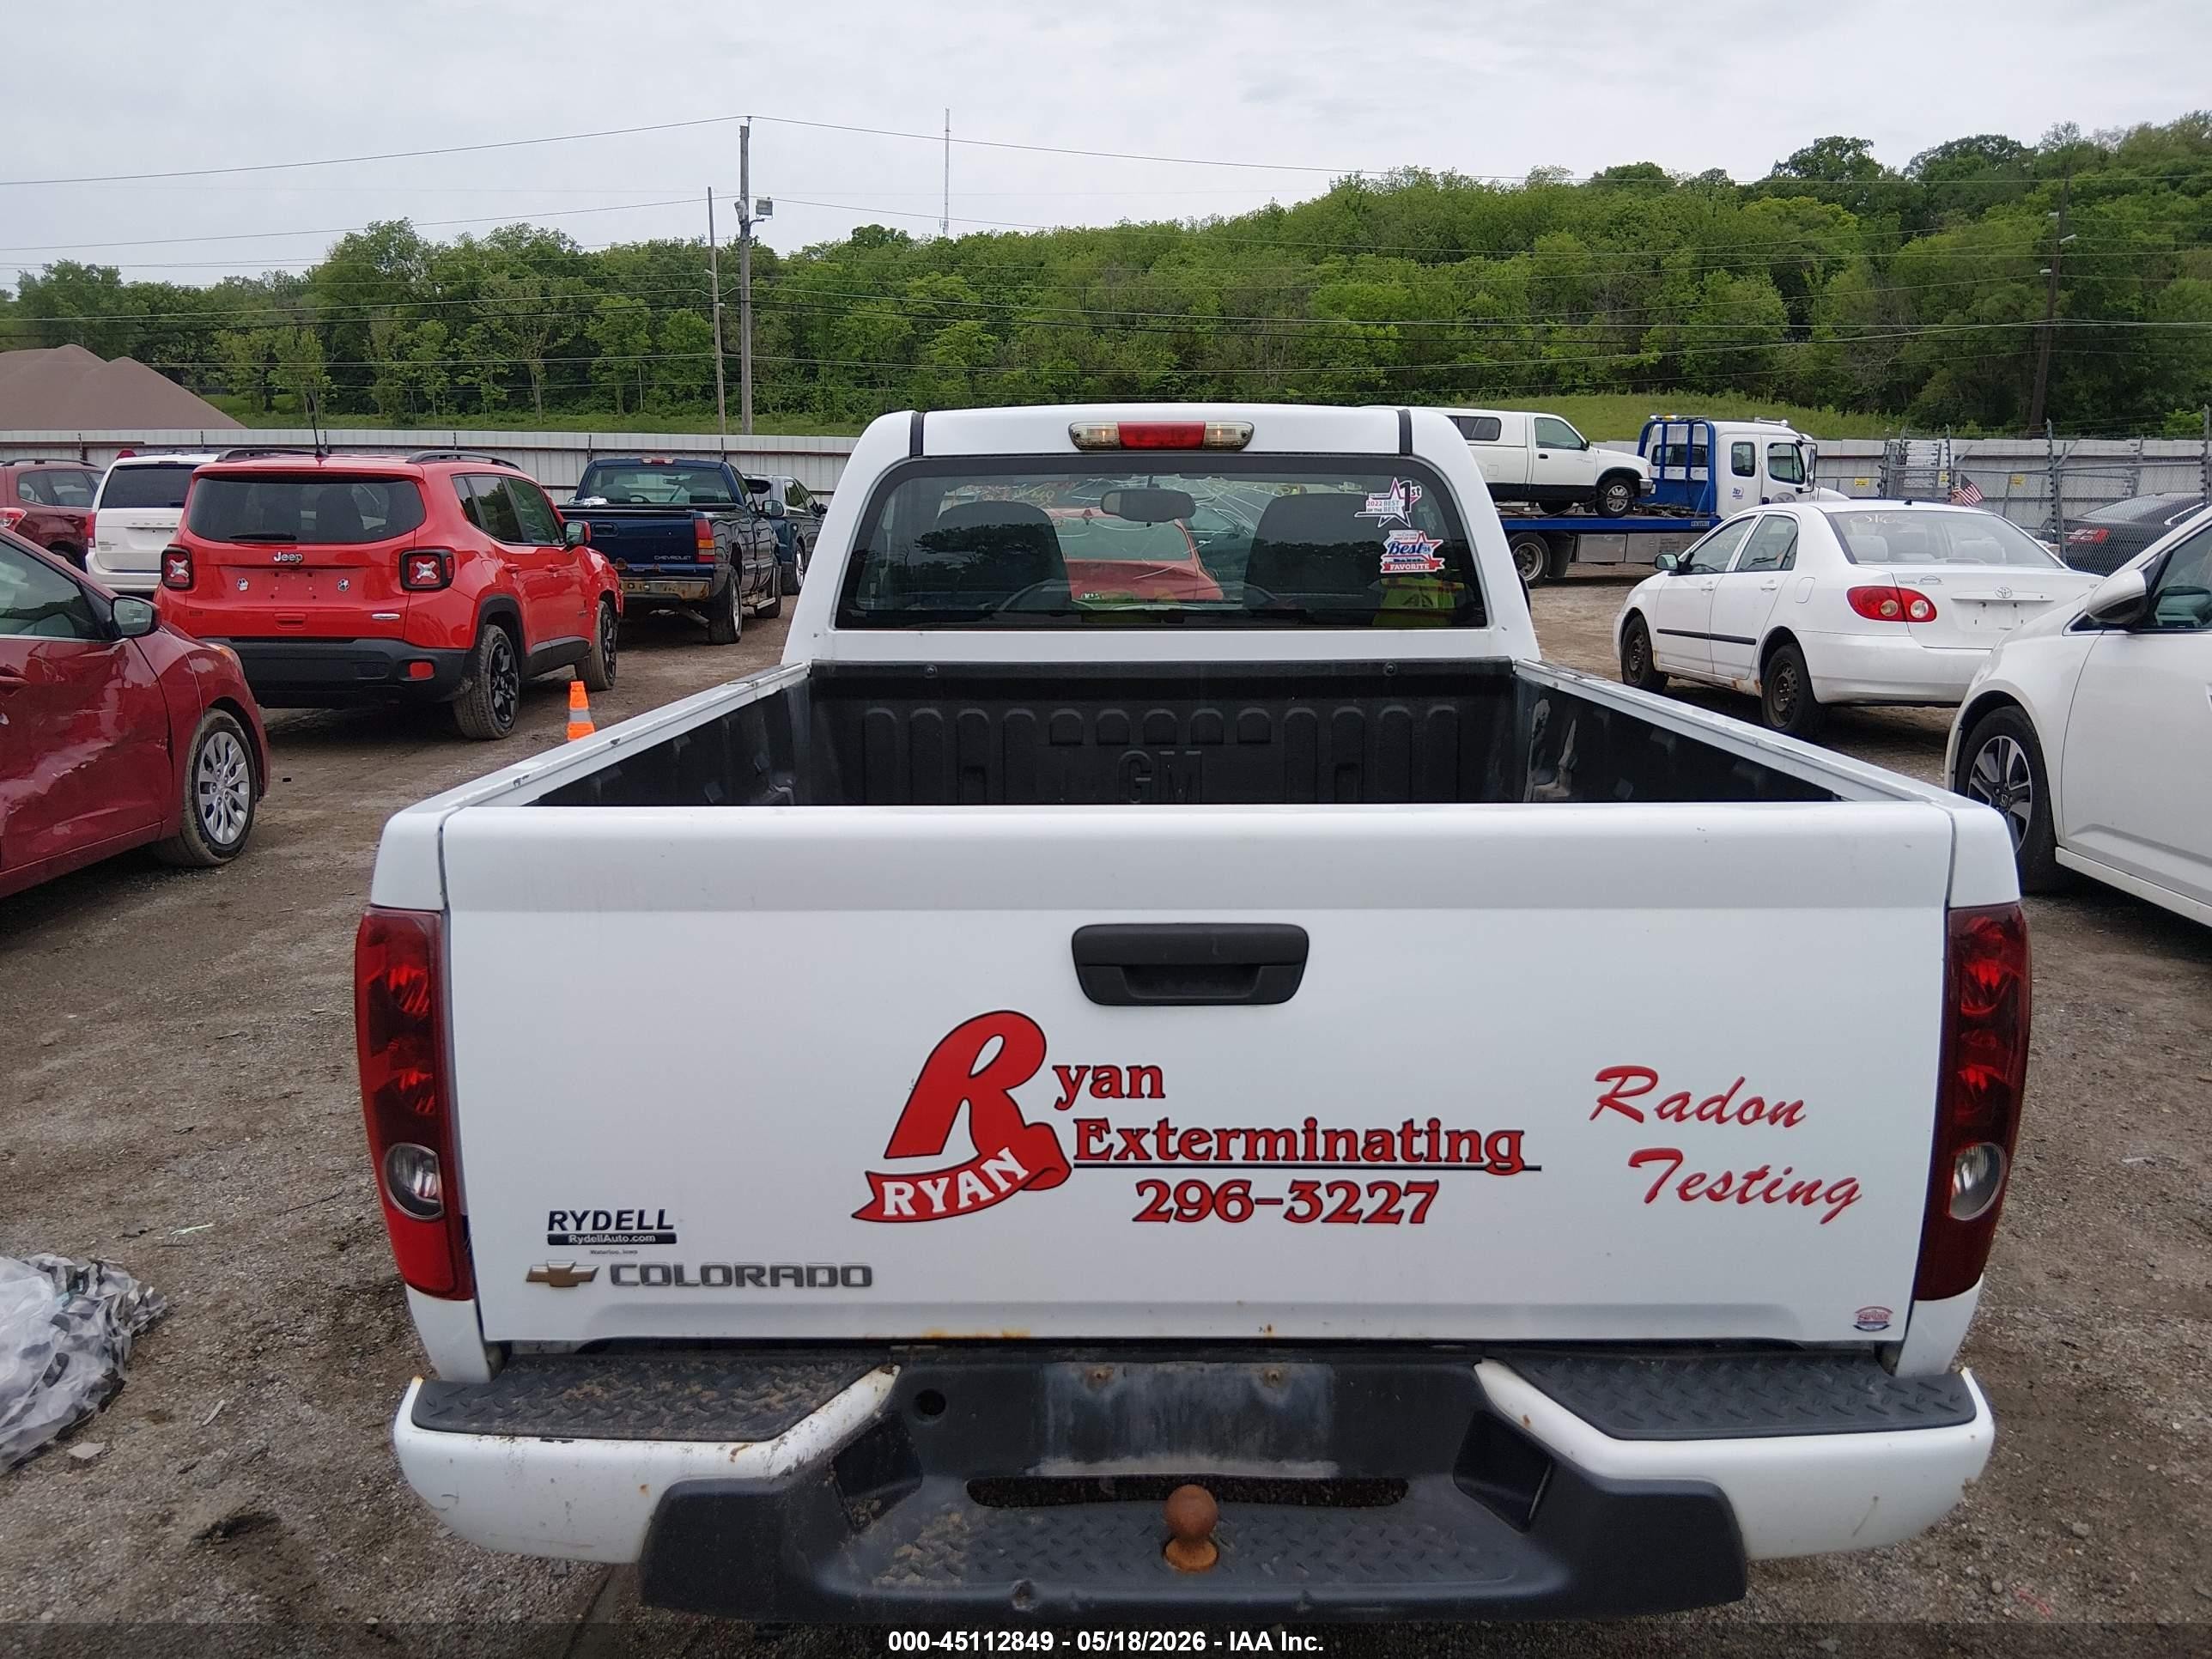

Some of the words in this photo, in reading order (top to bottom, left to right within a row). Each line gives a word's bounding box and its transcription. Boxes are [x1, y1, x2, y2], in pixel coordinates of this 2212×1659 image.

[273, 551, 303, 564] Jeep
[1388, 540, 1423, 555] Best
[1589, 1065, 1806, 1128] Radon
[1073, 1117, 1525, 1176] Exterminating
[881, 1147, 1030, 1216] RYAN
[1627, 1147, 1862, 1224] Testing
[547, 1208, 675, 1231] RYDELL
[1133, 1179, 1439, 1225] 296-3227
[568, 1234, 657, 1245] RydellAuto.com
[610, 1262, 873, 1287] COLORADO
